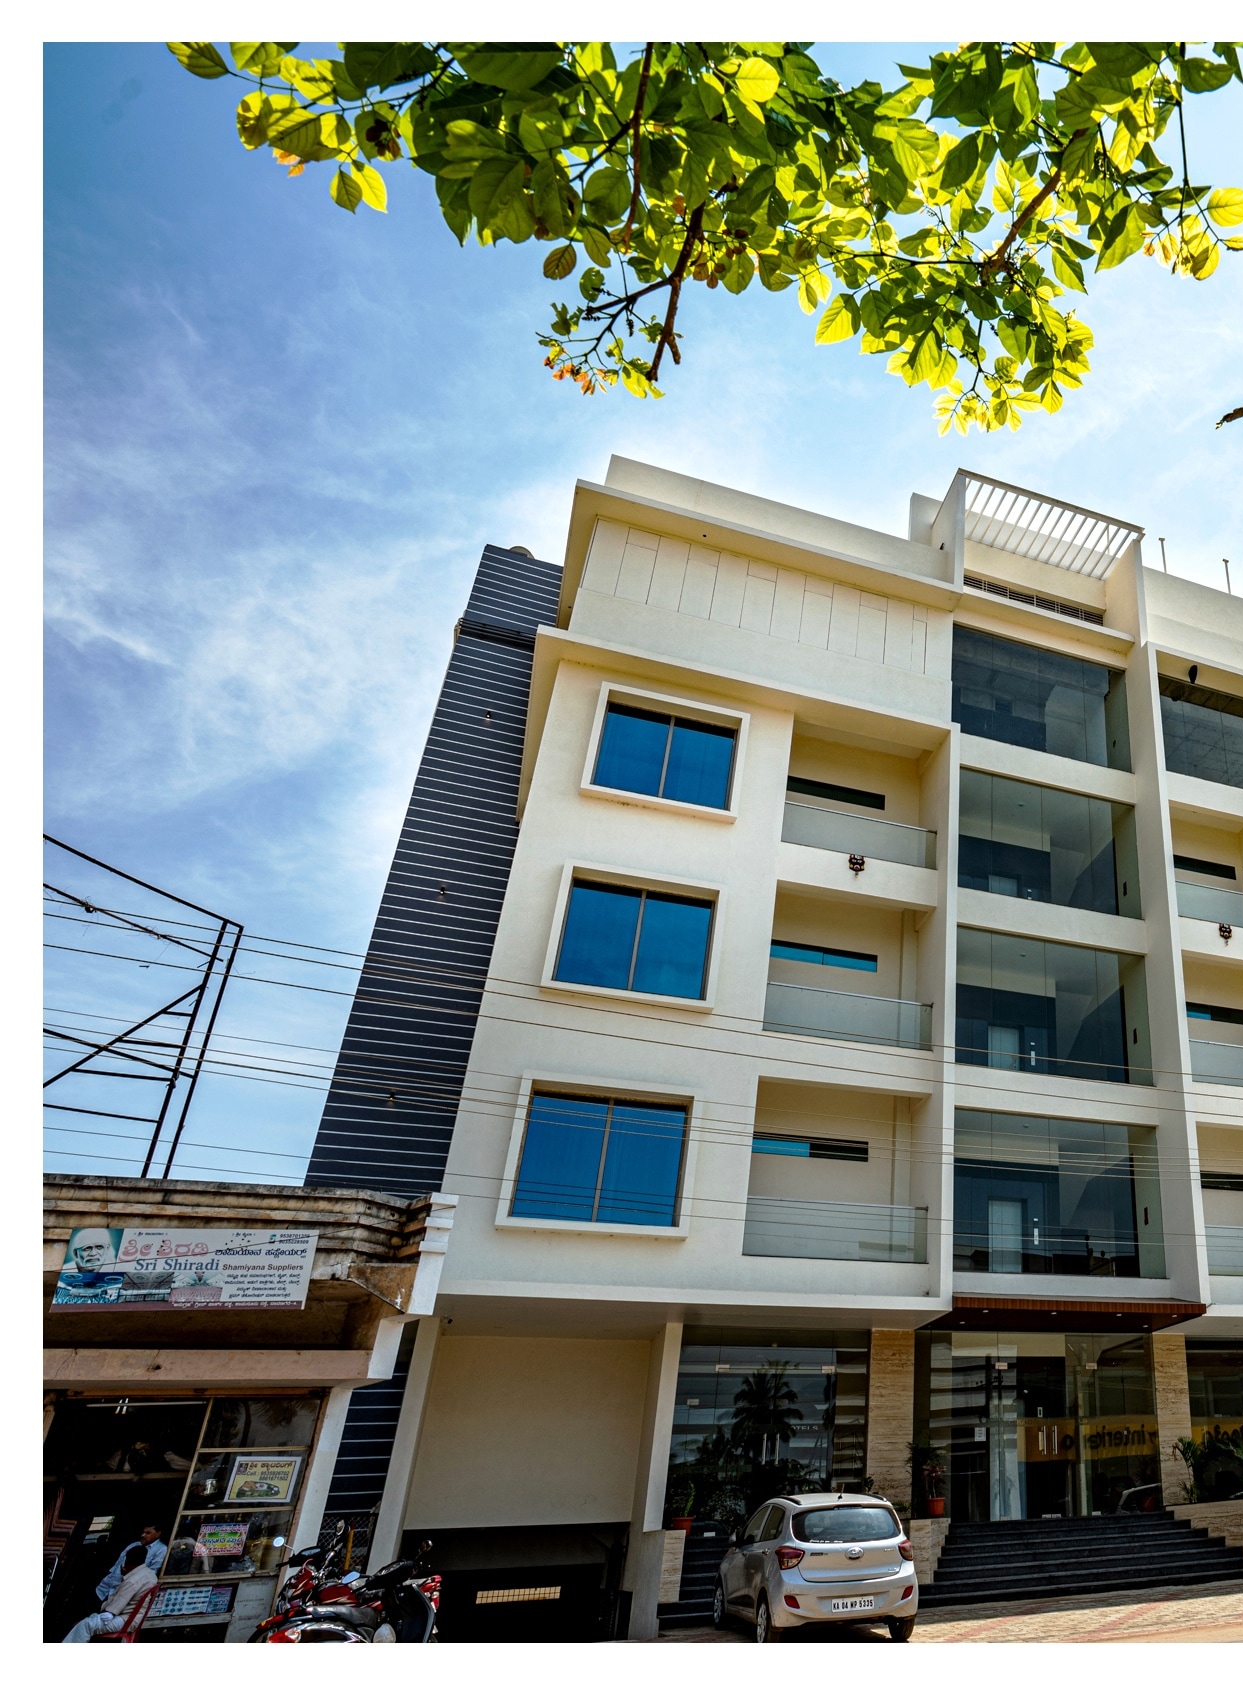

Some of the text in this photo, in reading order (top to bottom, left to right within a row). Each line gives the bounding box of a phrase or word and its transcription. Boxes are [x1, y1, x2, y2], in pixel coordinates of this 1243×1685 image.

[134, 1258, 304, 1273] Sri Shiradi Shamiyana Suppliers
